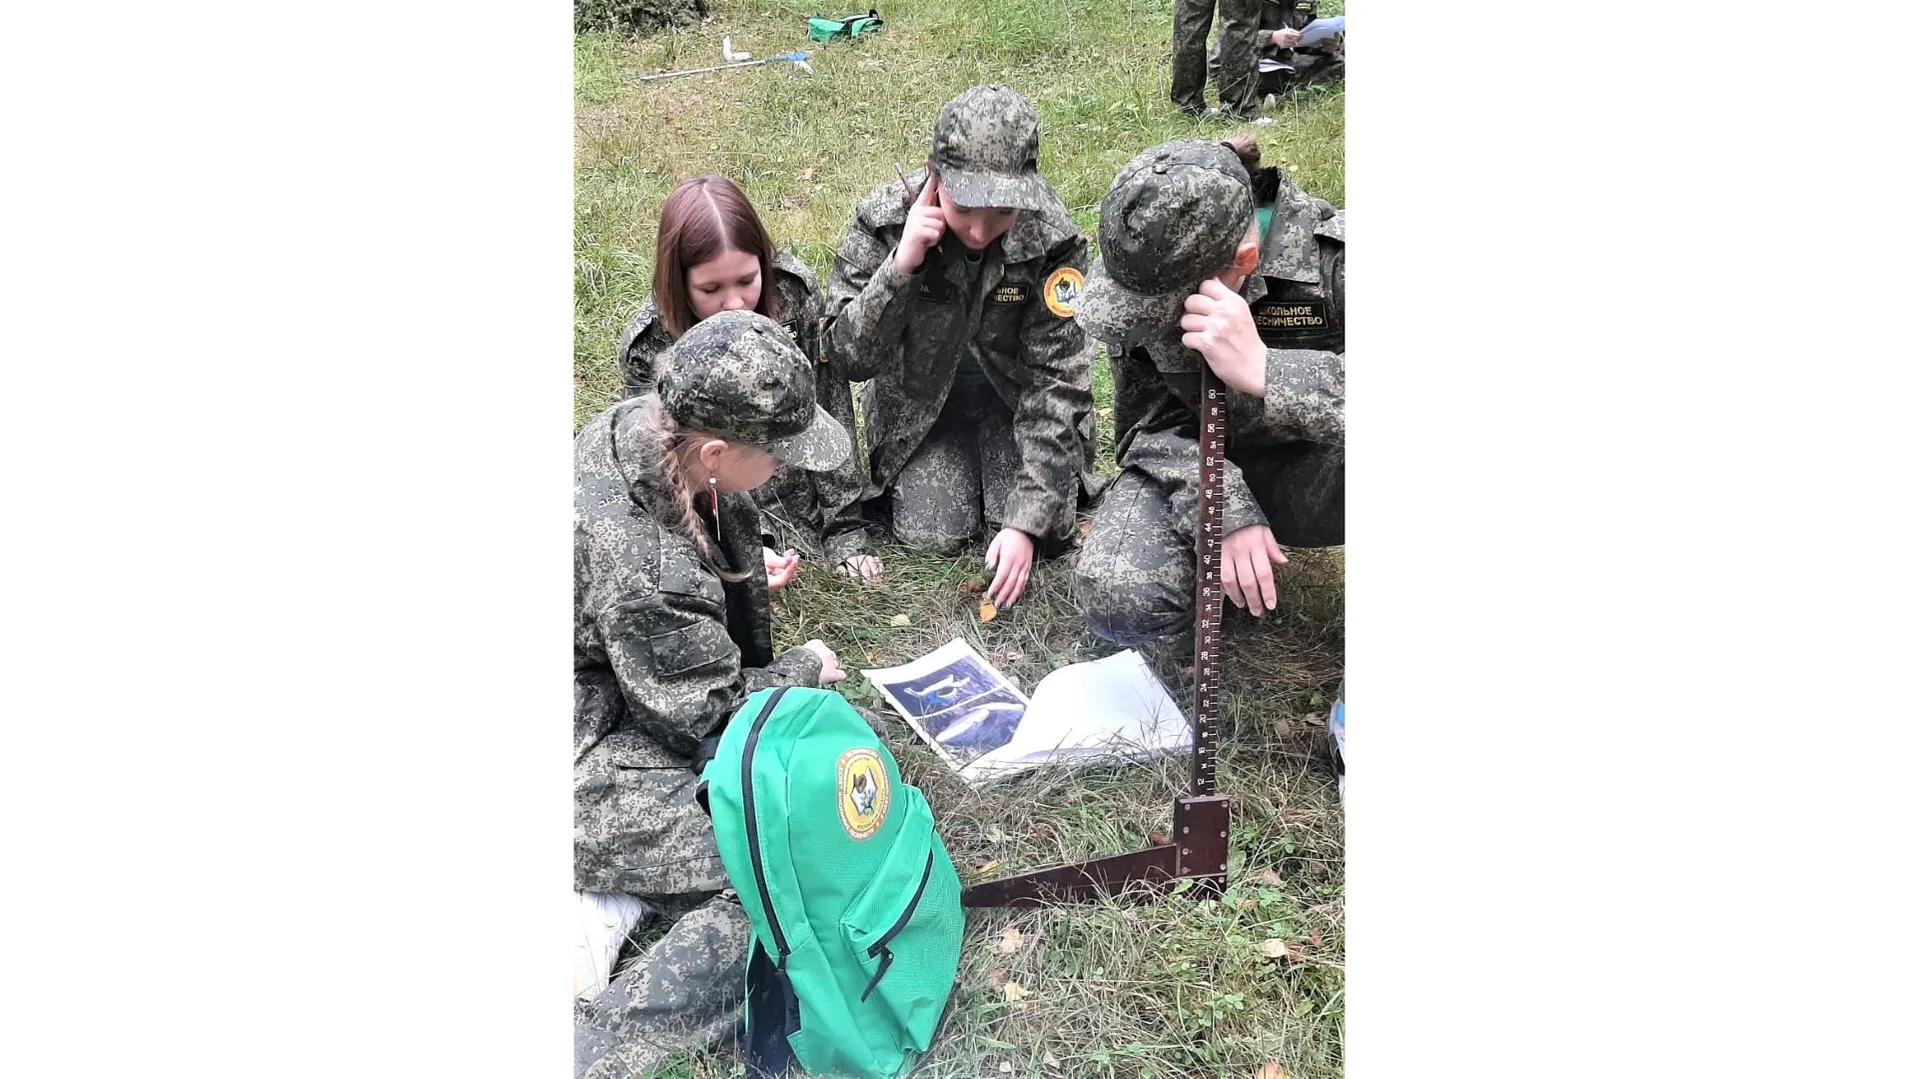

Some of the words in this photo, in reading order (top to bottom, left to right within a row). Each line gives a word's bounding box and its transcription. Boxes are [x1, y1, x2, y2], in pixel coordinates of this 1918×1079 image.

[1258, 306, 1312, 316] ШКОЛЬНОЕ
[1208, 390, 1216, 399] 60
[1212, 408, 1218, 416] 58
[1208, 424, 1214, 432] 56
[1206, 456, 1214, 466] 52
[1210, 474, 1216, 482] 50
[1206, 489, 1213, 499] 48
[1208, 506, 1214, 514] 46
[1204, 522, 1212, 532] 44
[1208, 539, 1214, 548] 42
[1204, 555, 1210, 564] 40
[1206, 572, 1212, 580] 38
[1203, 587, 1210, 596] 36
[1206, 604, 1212, 612] 34
[1202, 619, 1209, 628] 32
[1205, 636, 1211, 644] 30
[1200, 651, 1208, 660] 28
[1204, 668, 1210, 676] 26
[1200, 684, 1207, 692] 24
[1203, 699, 1210, 707] 22
[1199, 714, 1206, 723] 20
